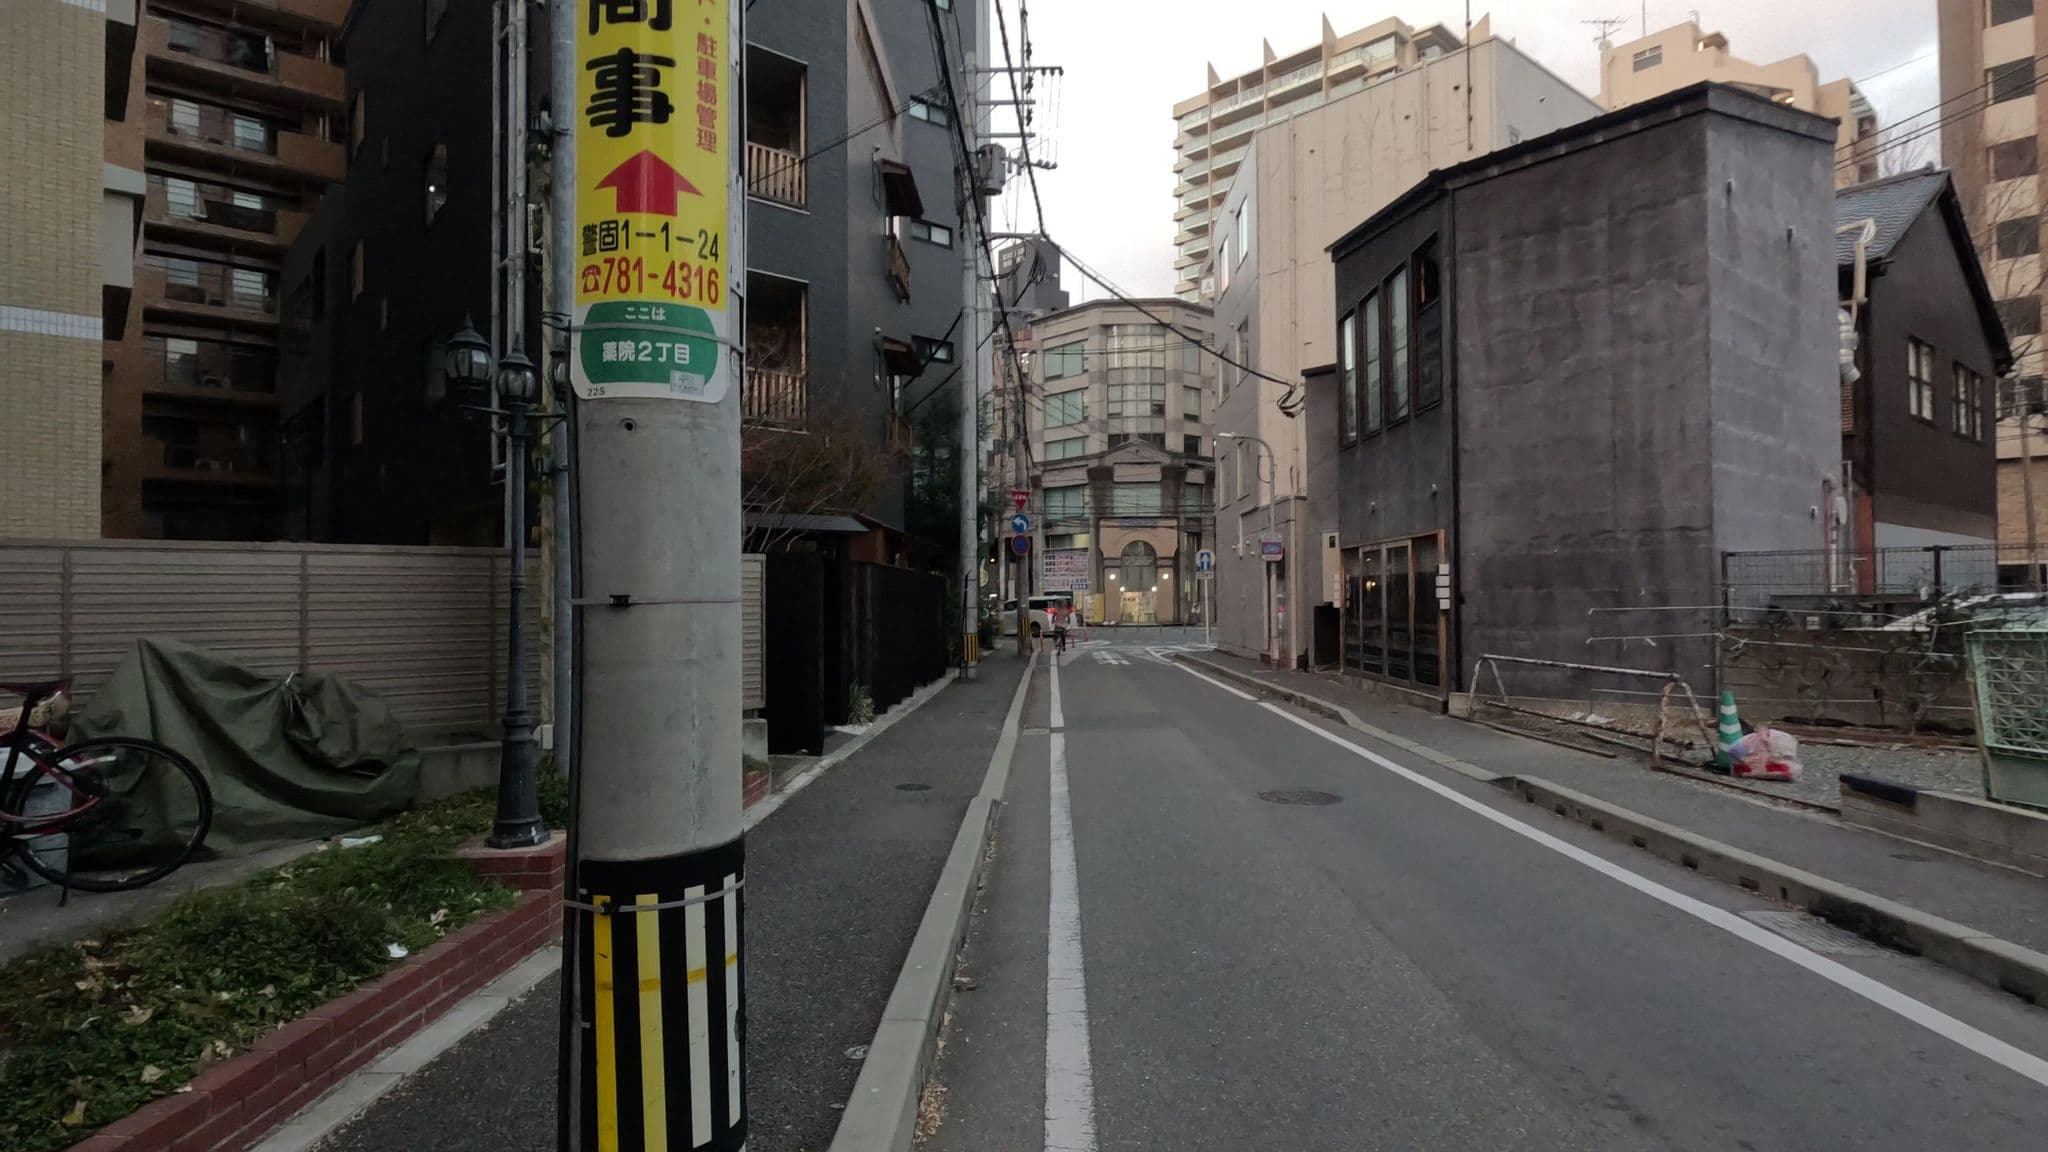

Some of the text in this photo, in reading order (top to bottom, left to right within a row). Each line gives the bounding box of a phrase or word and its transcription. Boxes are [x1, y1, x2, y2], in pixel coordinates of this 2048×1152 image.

[603, 256, 719, 305] 781-4316
[625, 306, 667, 321] ここは
[602, 340, 690, 364] 薬院2丁目
